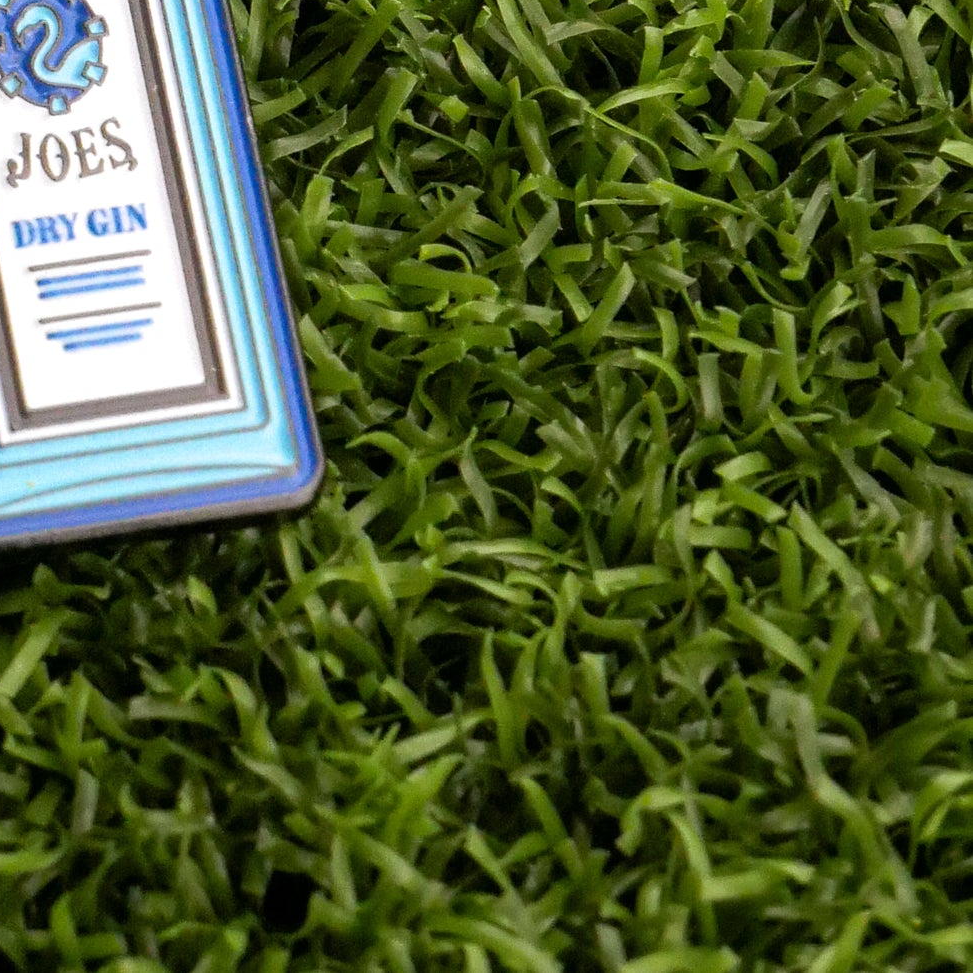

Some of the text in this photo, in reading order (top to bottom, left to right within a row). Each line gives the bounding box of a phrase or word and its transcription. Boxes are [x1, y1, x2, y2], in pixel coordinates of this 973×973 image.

[6, 117, 138, 188] JOES
[11, 202, 148, 249] DRY GIN
